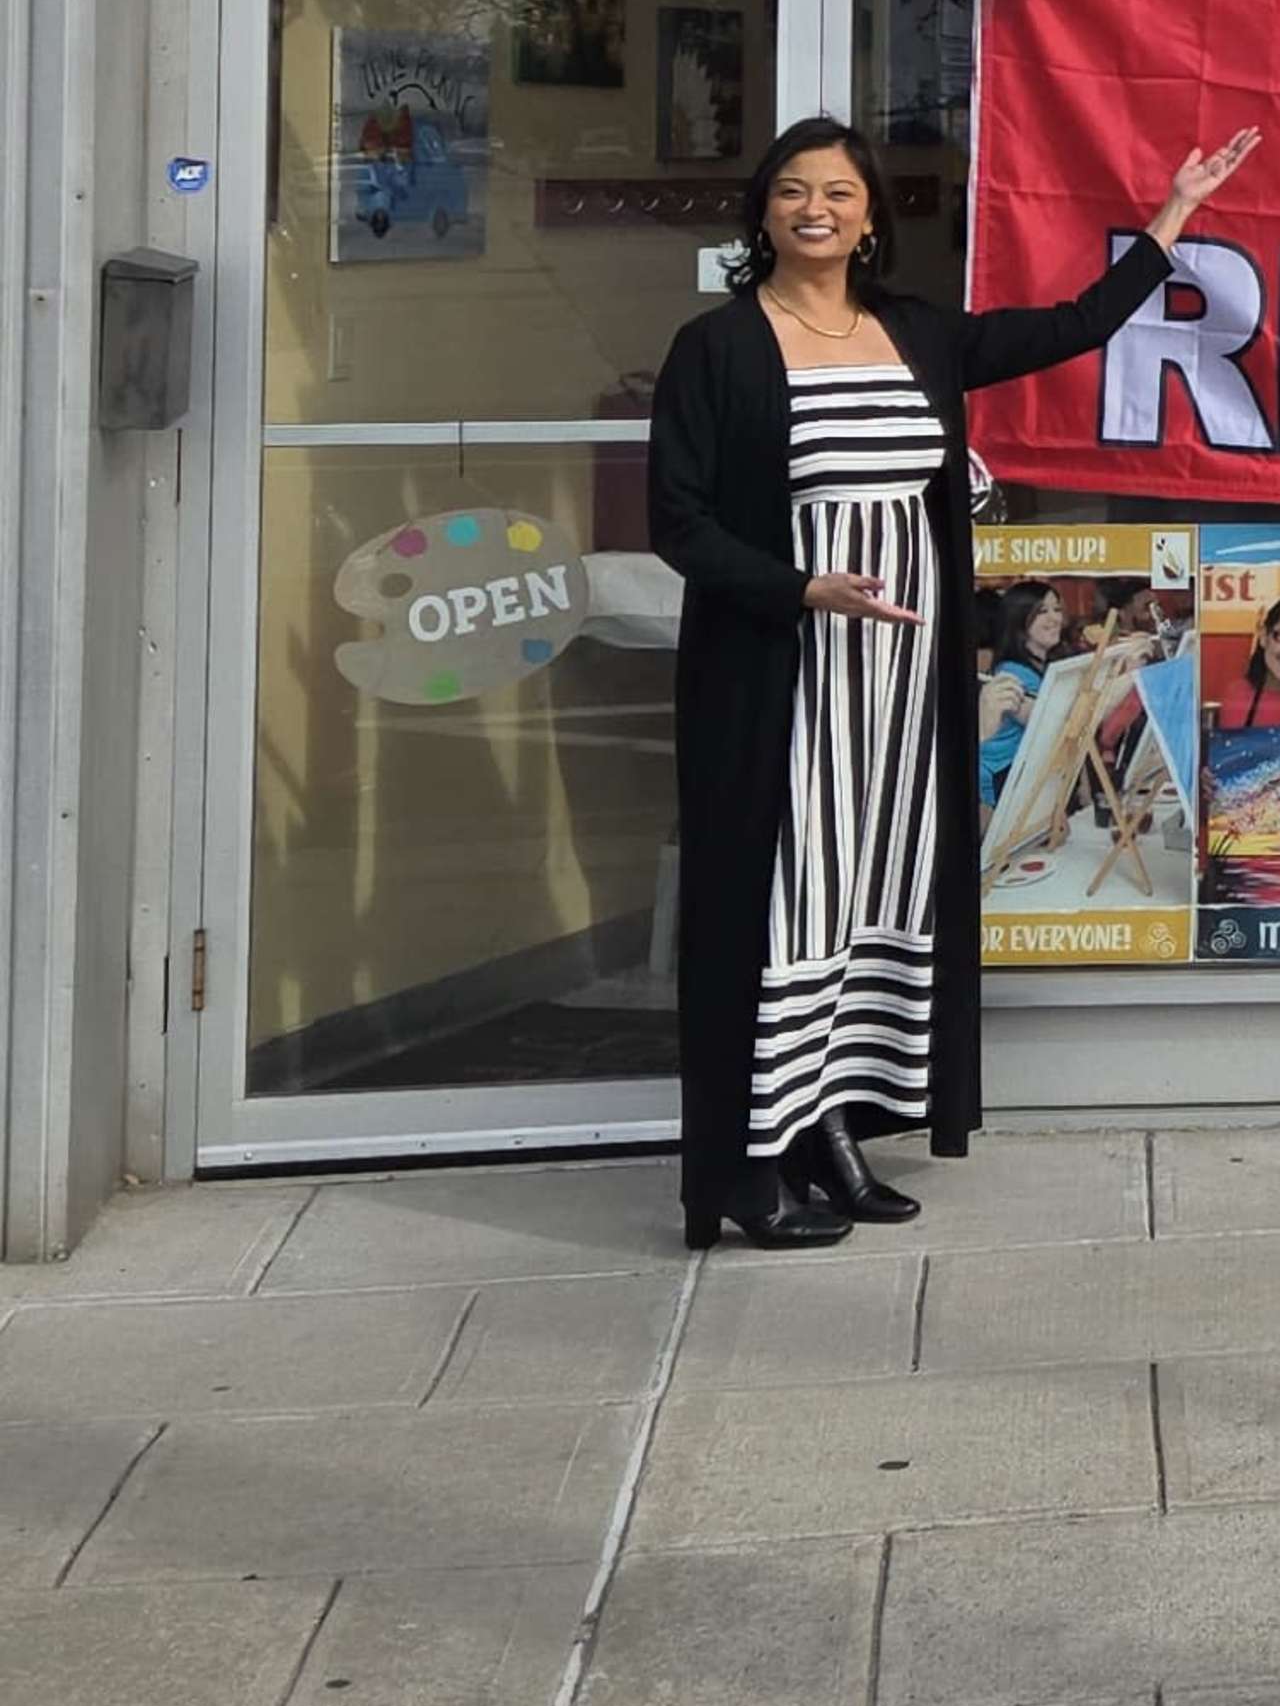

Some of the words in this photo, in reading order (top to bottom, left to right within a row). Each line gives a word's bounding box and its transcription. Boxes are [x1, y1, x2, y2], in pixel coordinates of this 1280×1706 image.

[1010, 537, 1059, 565] SIGN
[1066, 537, 1106, 564] UP!
[408, 565, 571, 642] OPEN
[1010, 922, 1131, 953] EVERYONE!
